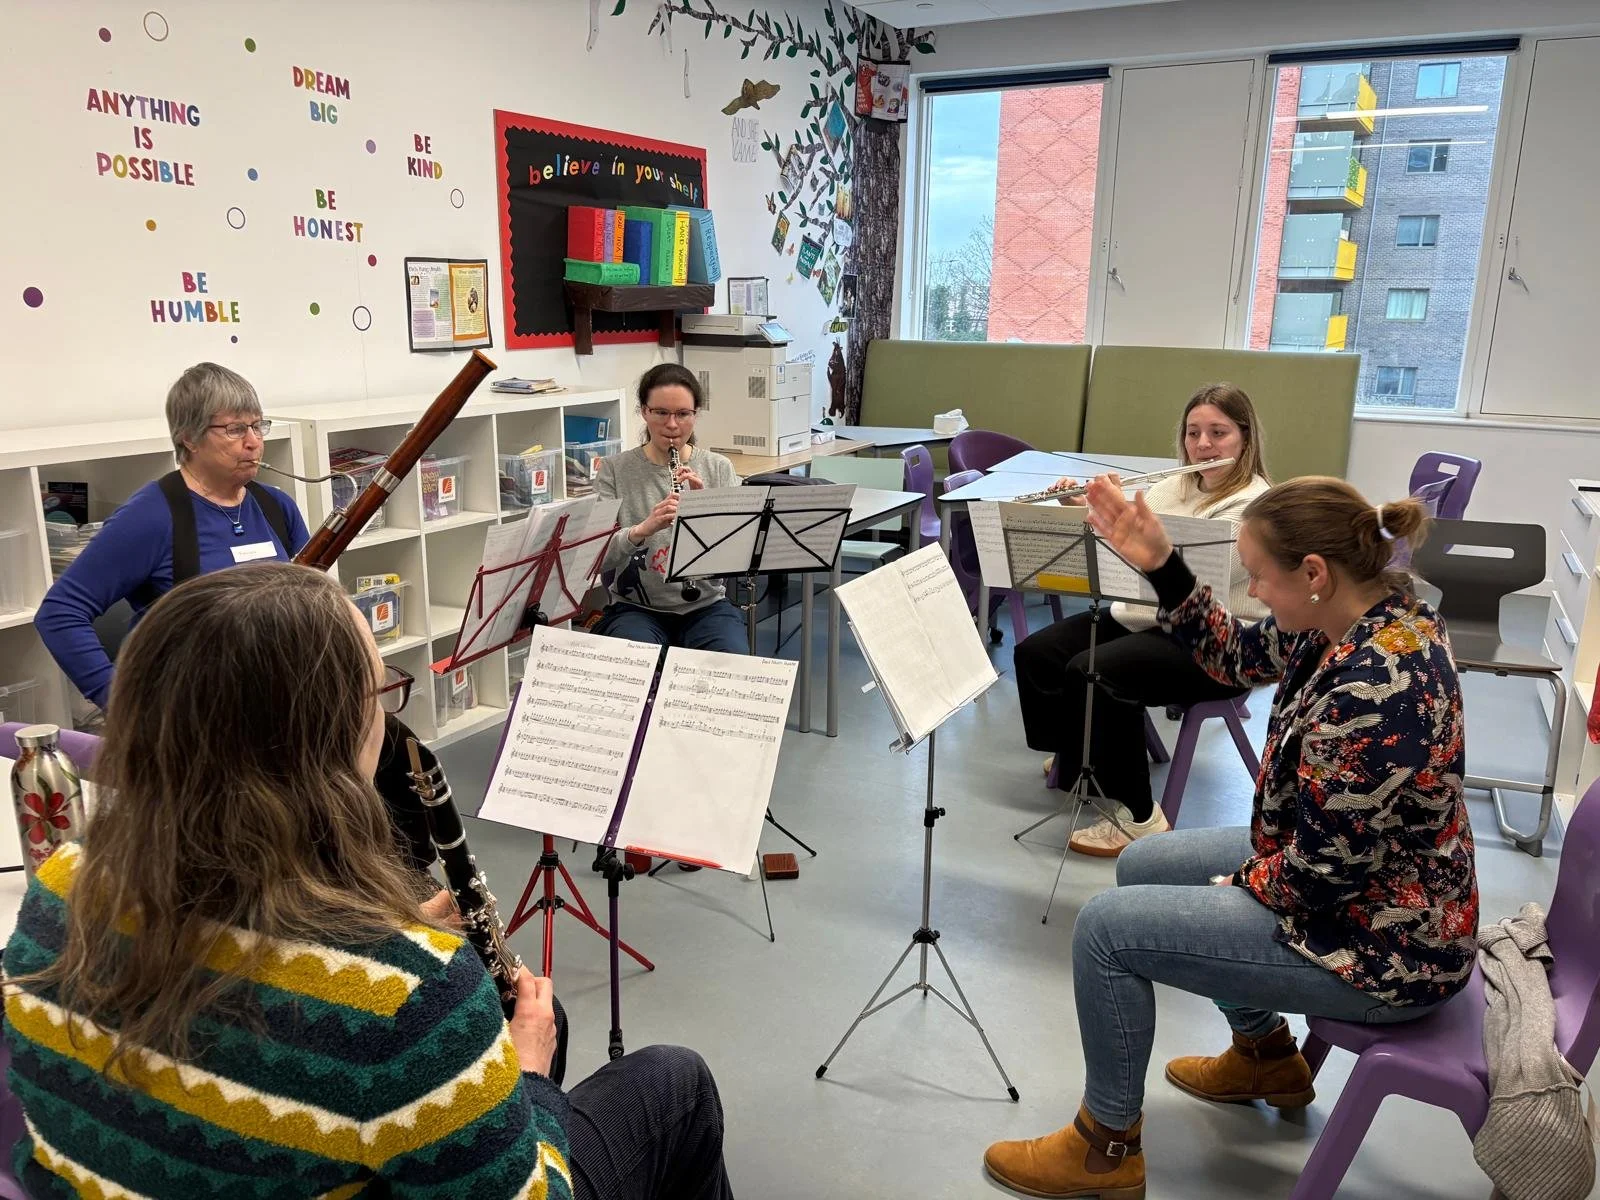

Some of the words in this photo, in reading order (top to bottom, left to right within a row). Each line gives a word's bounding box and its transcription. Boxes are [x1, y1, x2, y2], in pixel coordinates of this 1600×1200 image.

[292, 66, 351, 100] DREAM
[87, 88, 200, 127] ANYTHING
[309, 101, 338, 125] BIG
[133, 126, 154, 150] IS
[414, 133, 432, 154] BE
[96, 152, 195, 186] POSSIBLE
[407, 156, 443, 180] KIND
[529, 153, 600, 185] believe
[611, 155, 625, 175] in
[635, 163, 664, 184] your
[669, 173, 699, 205] shelf
[315, 189, 336, 210] BE
[293, 216, 363, 243] HONEST
[182, 271, 208, 294] BE
[151, 300, 240, 323] HUMBLE
